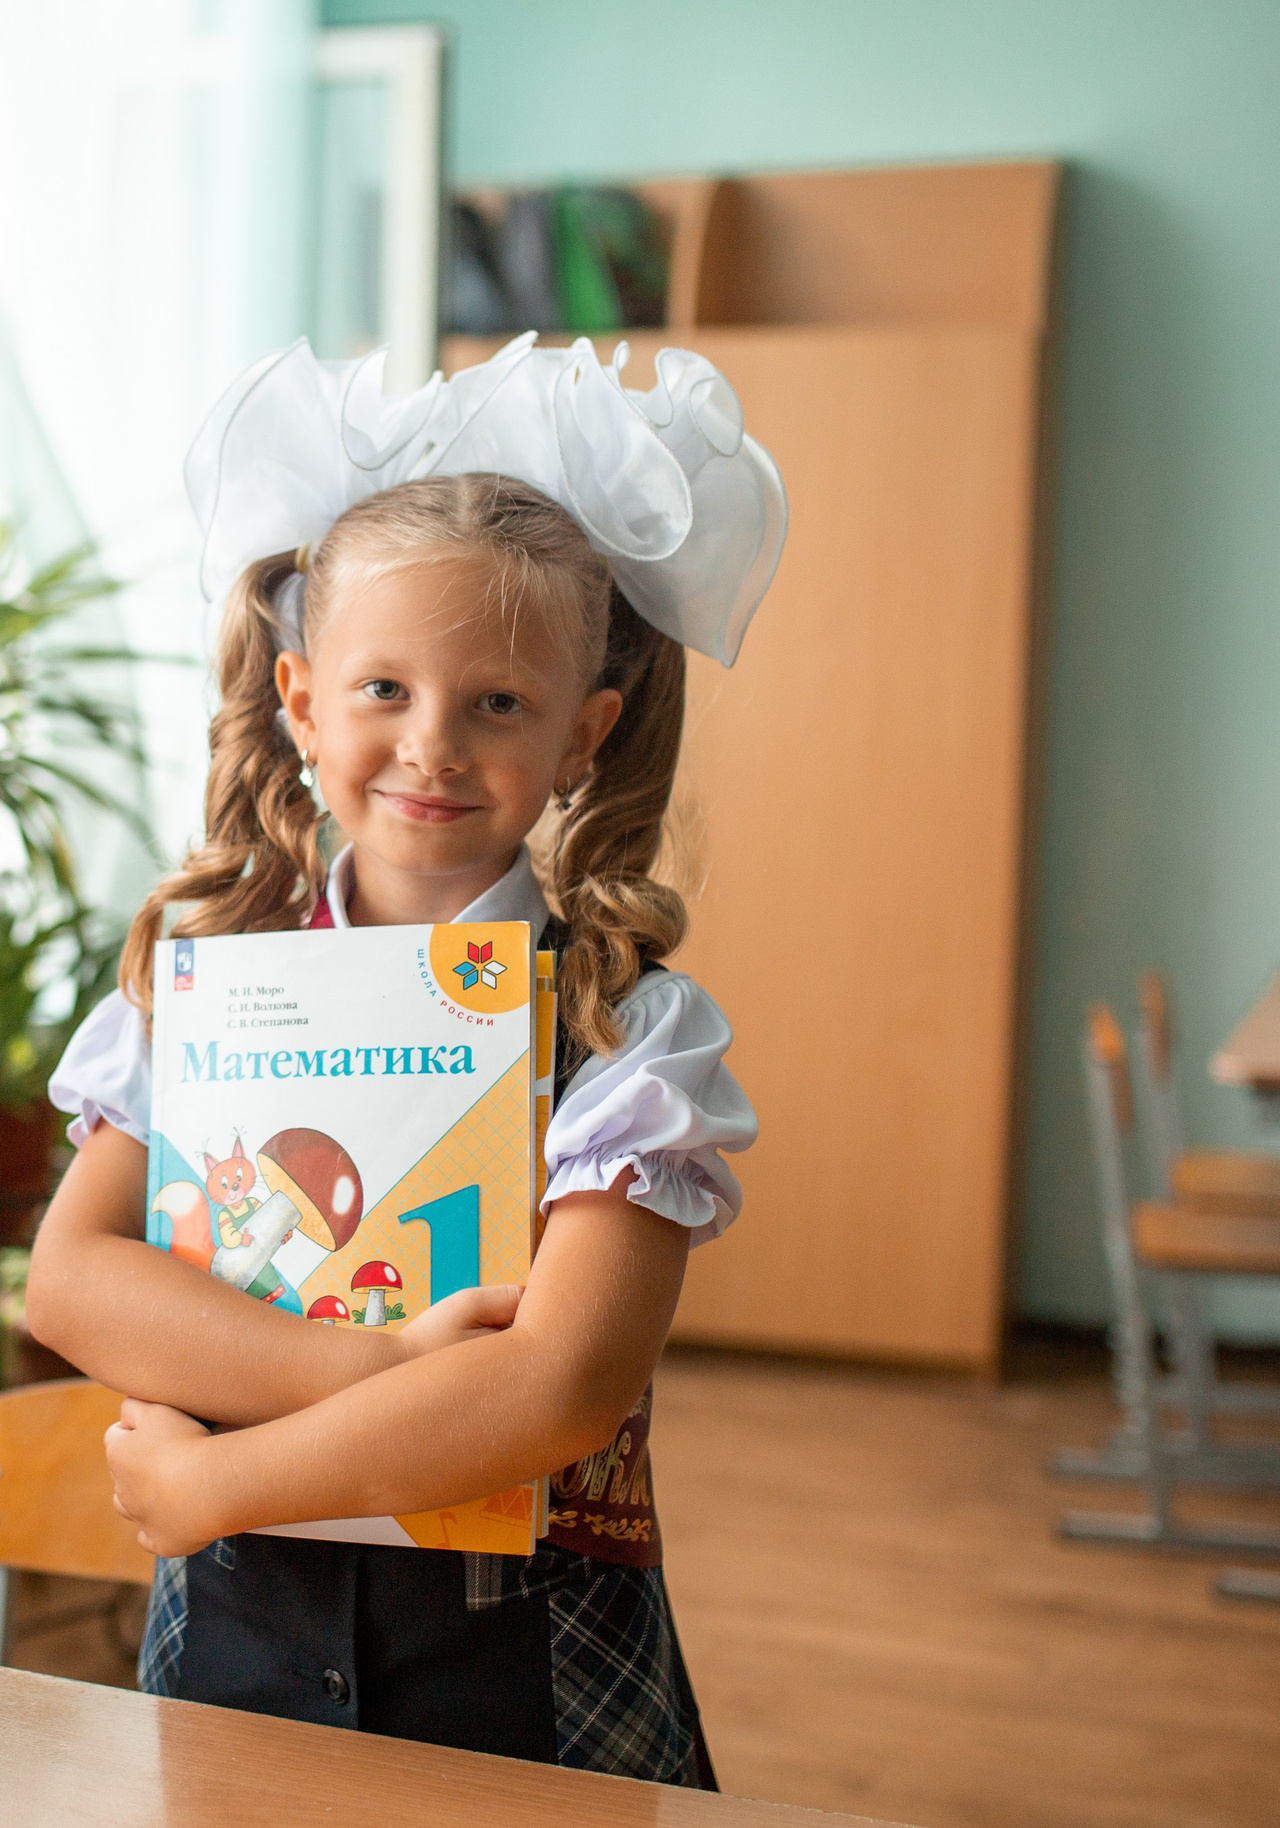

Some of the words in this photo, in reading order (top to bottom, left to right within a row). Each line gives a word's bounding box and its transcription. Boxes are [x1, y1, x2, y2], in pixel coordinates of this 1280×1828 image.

[228, 987, 240, 998] М.
[242, 986, 254, 997] И.
[256, 985, 285, 998] Моро
[417, 948, 437, 997] ШКОЛА
[440, 999, 494, 1027] РОССИИ
[227, 1002, 238, 1014] С.
[240, 1002, 251, 1013] И.
[253, 1001, 298, 1012] Волкова
[227, 1018, 238, 1029] С.
[239, 1018, 249, 1029] В.
[250, 1016, 309, 1028] Степанова
[180, 1040, 476, 1083] Математика
[398, 1184, 480, 1306] 1
